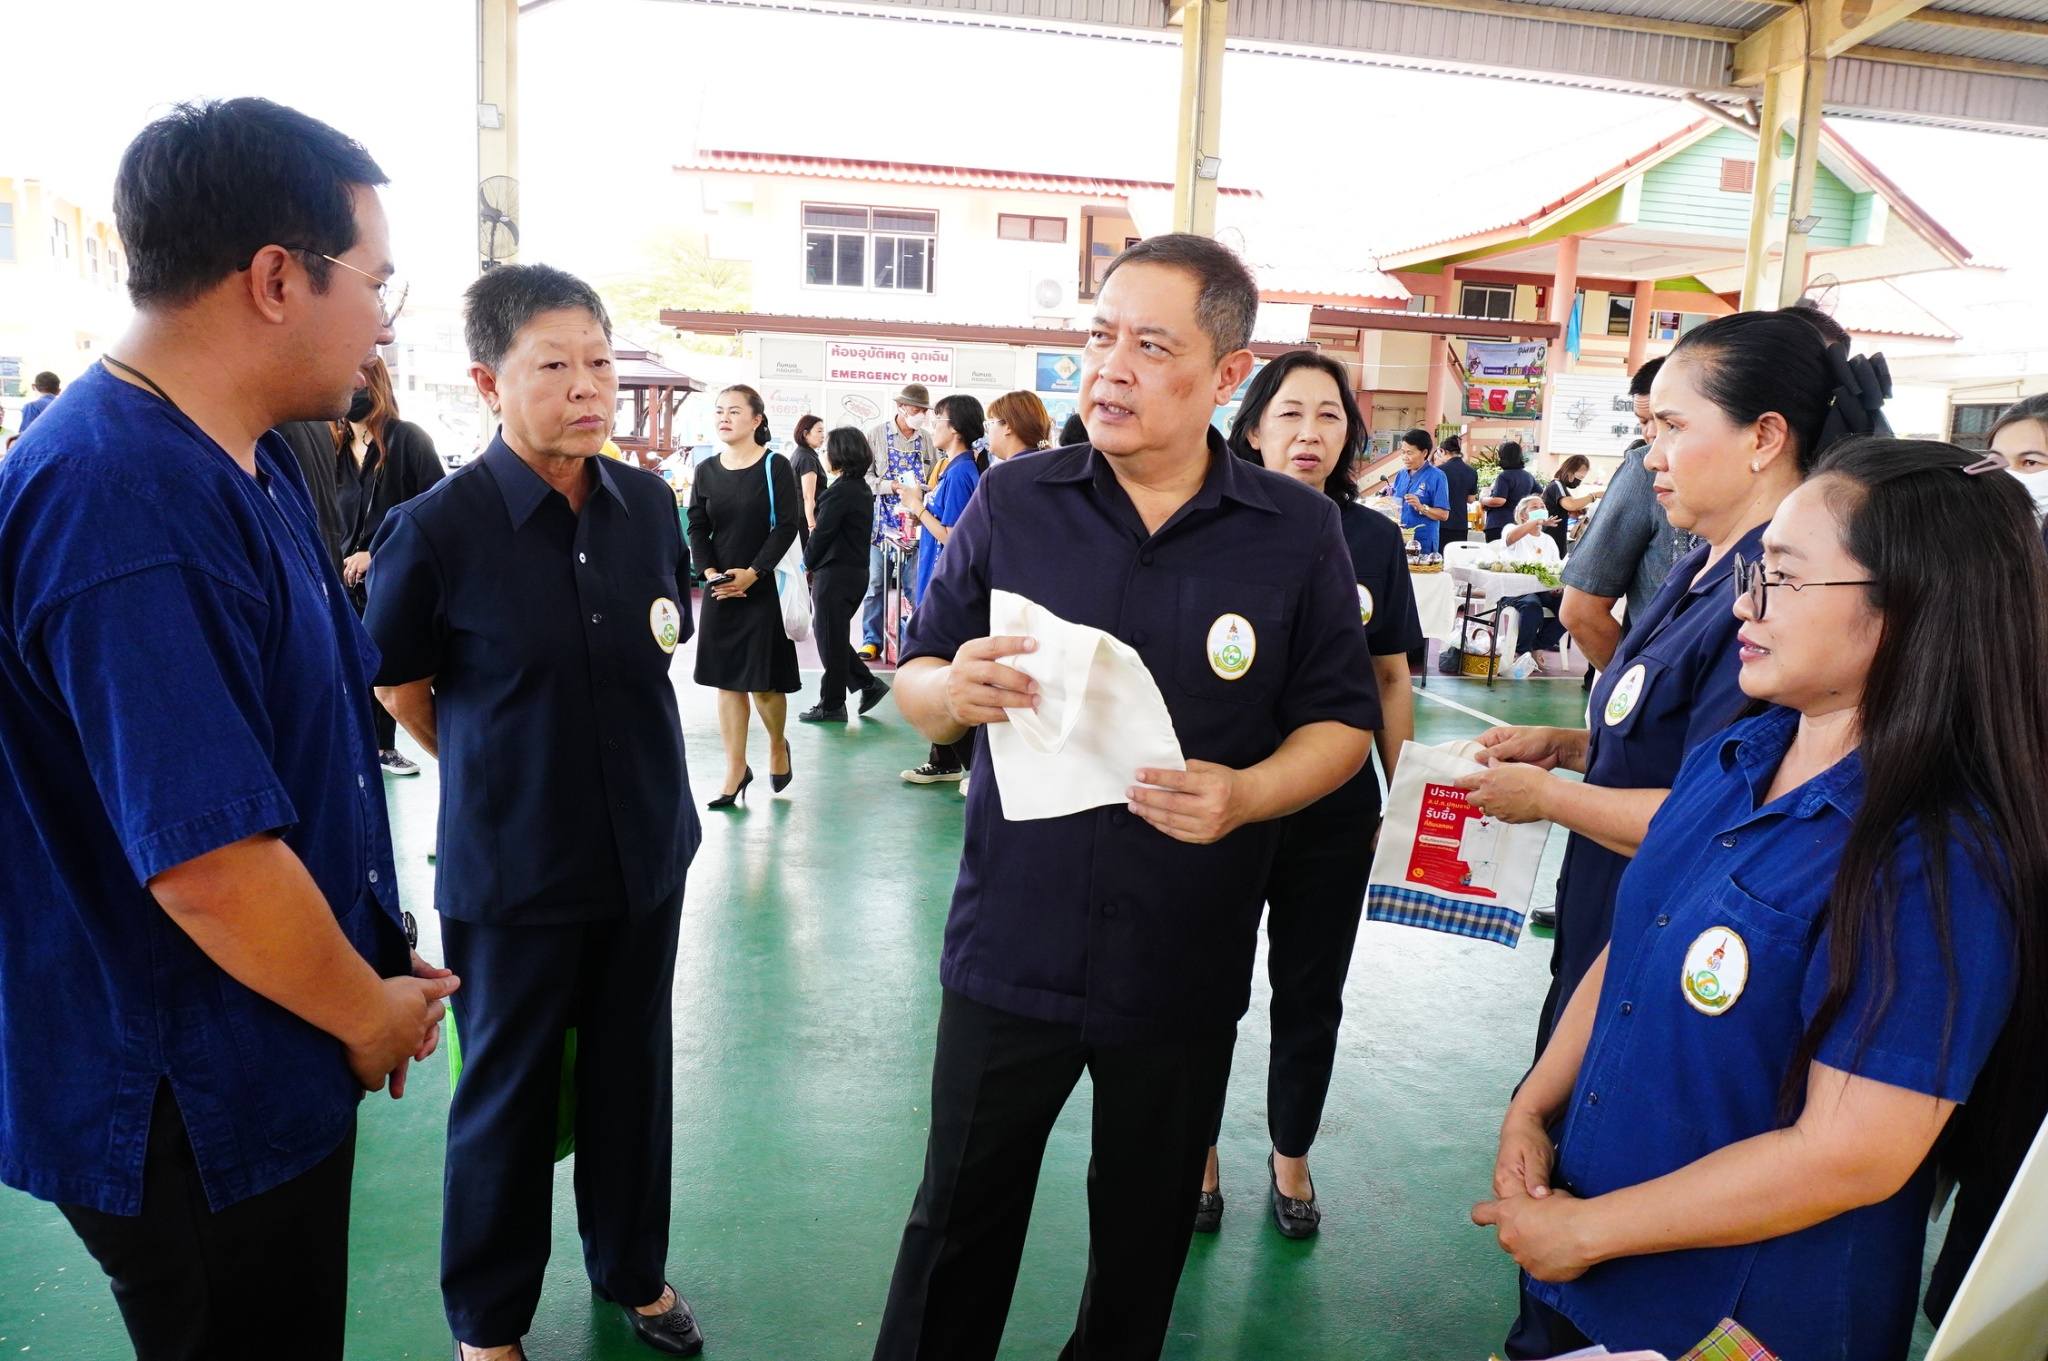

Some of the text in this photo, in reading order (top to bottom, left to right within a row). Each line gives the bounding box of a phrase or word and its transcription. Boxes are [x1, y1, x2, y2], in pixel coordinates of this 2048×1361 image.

[831, 344, 950, 364] ห้องอุบัติเหตุ ฉุกเฉิน
[831, 369, 949, 383] EMERGENCY ROOM
[1430, 787, 1467, 801] ประกา
[1425, 807, 1457, 821] รับซื้อ
